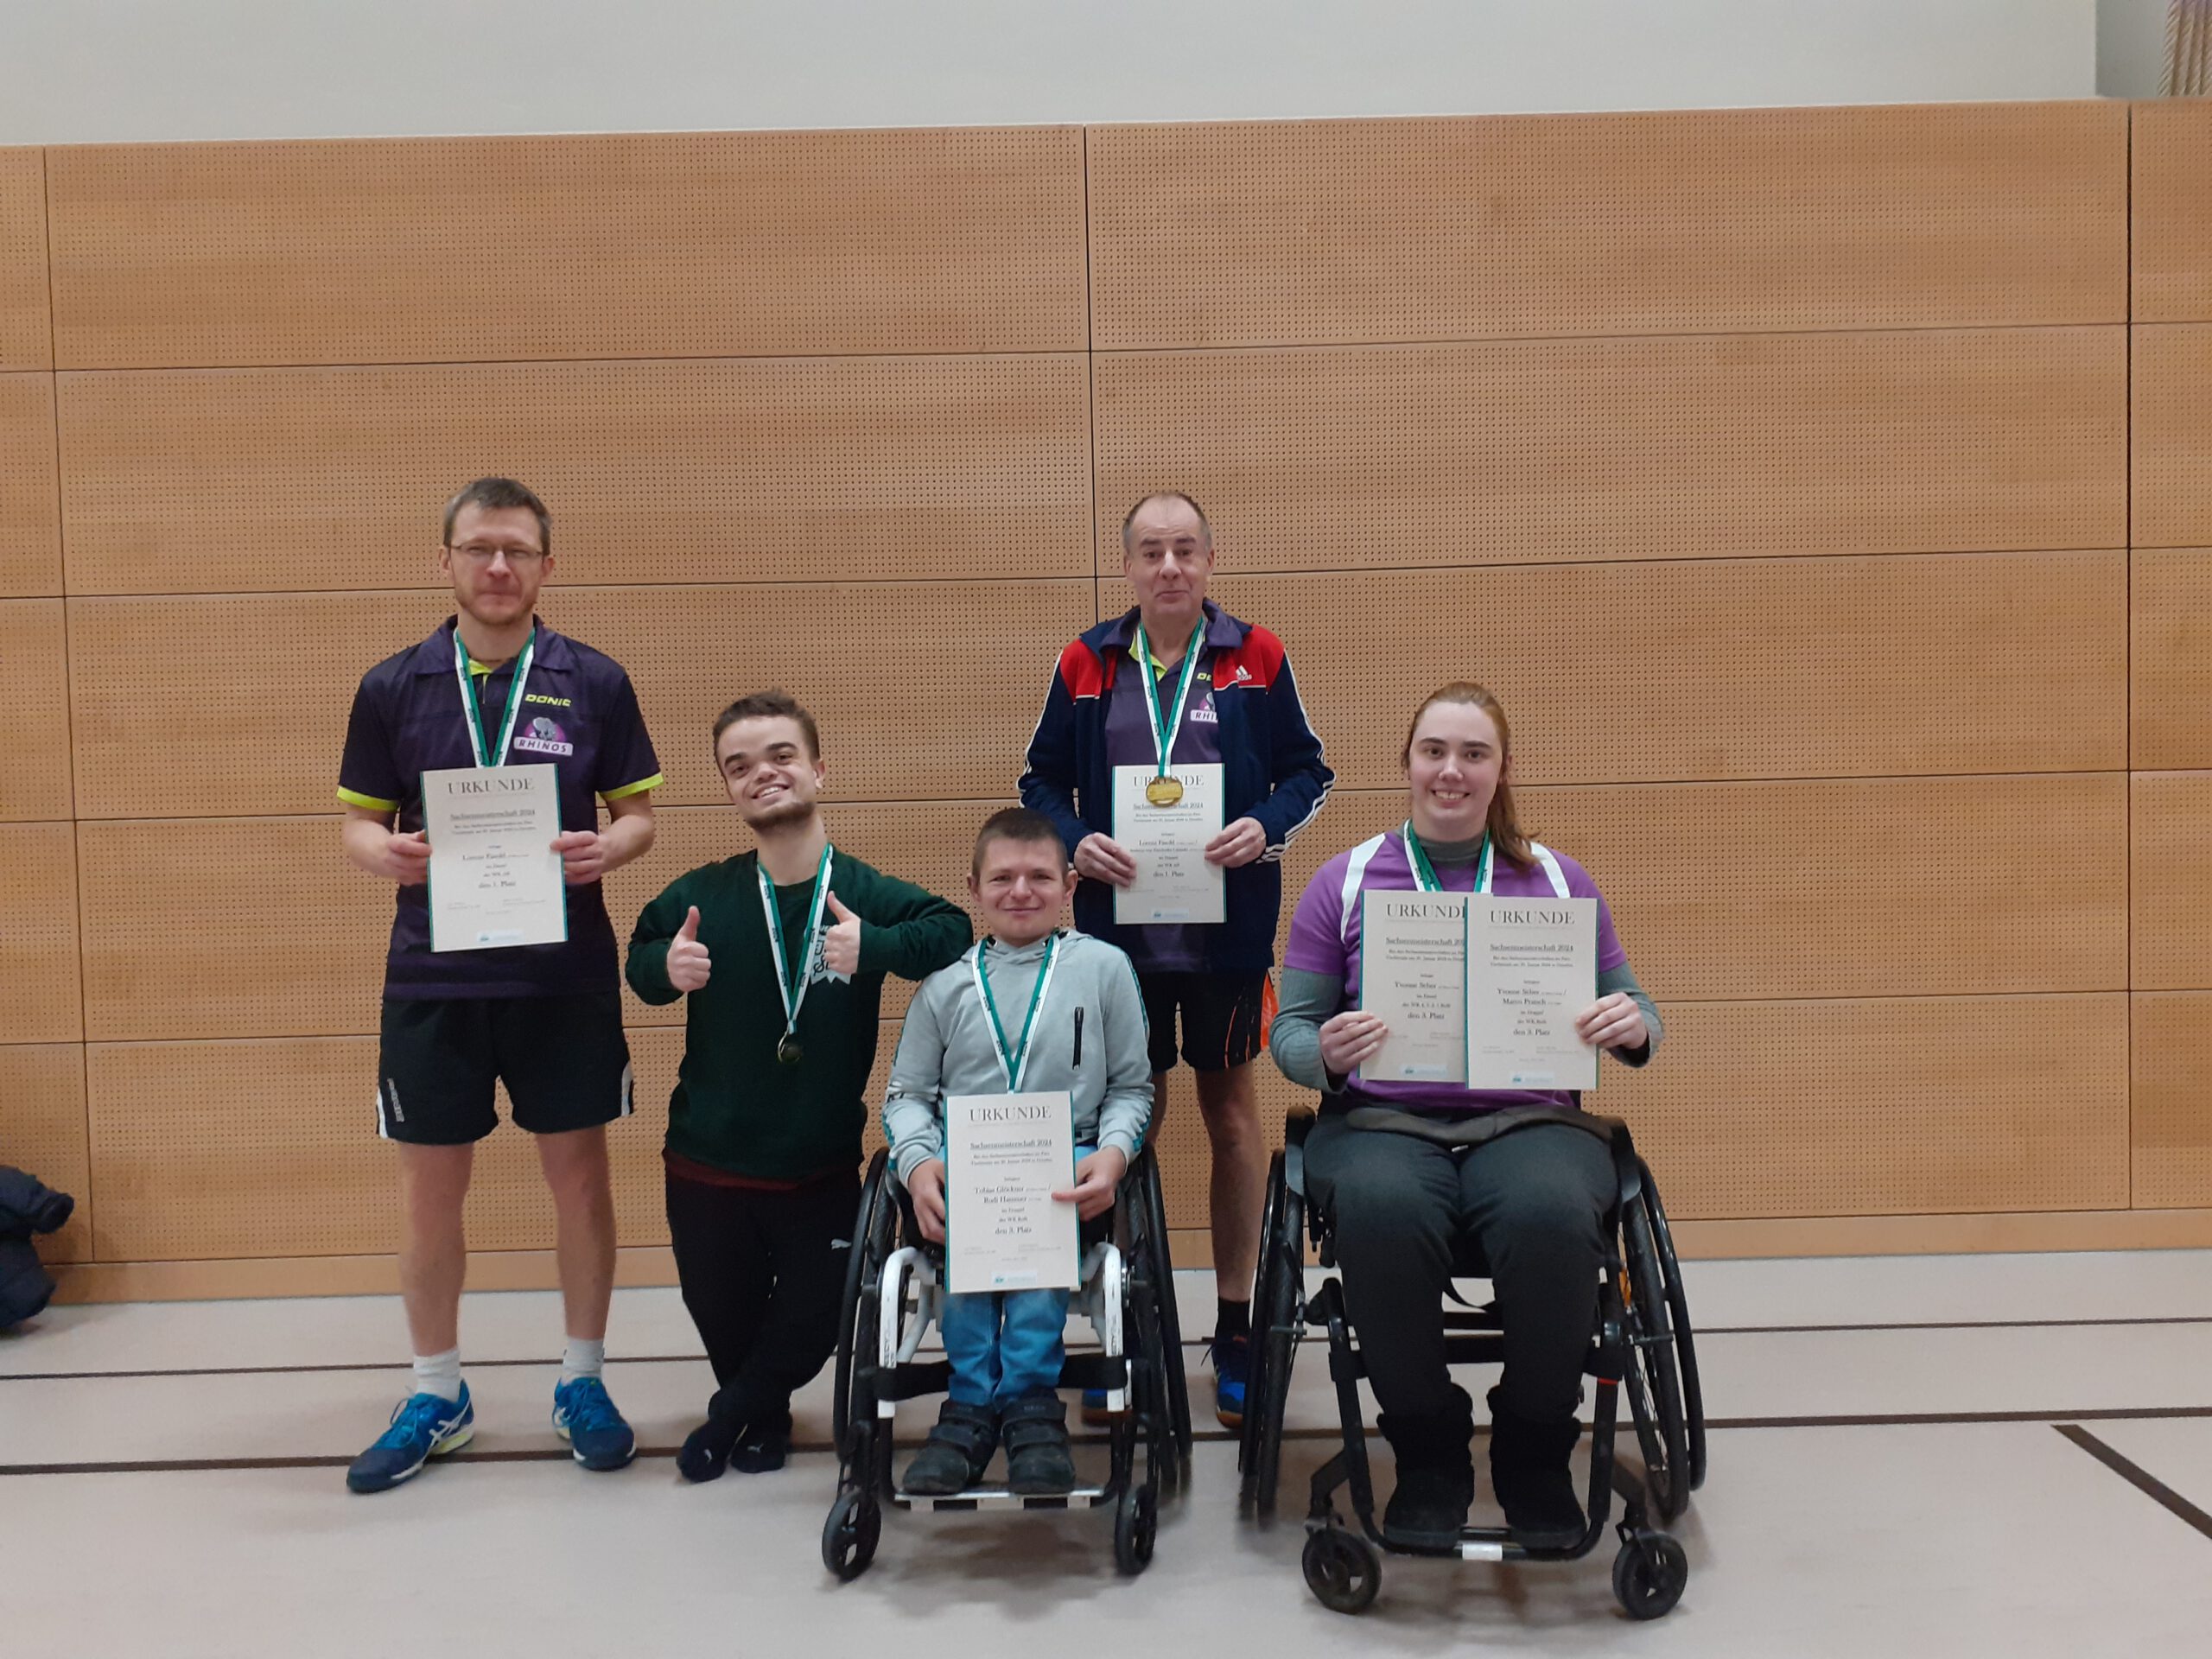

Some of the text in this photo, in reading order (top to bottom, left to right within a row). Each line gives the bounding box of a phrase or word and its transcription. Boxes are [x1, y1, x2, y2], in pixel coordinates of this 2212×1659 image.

[524, 694, 571, 707] DONIC
[518, 739, 567, 753] RHINOS
[448, 779, 535, 794] URKUNDE
[1491, 910, 1575, 925] URKUNDE
[969, 1105, 1052, 1122] URKUNDE
